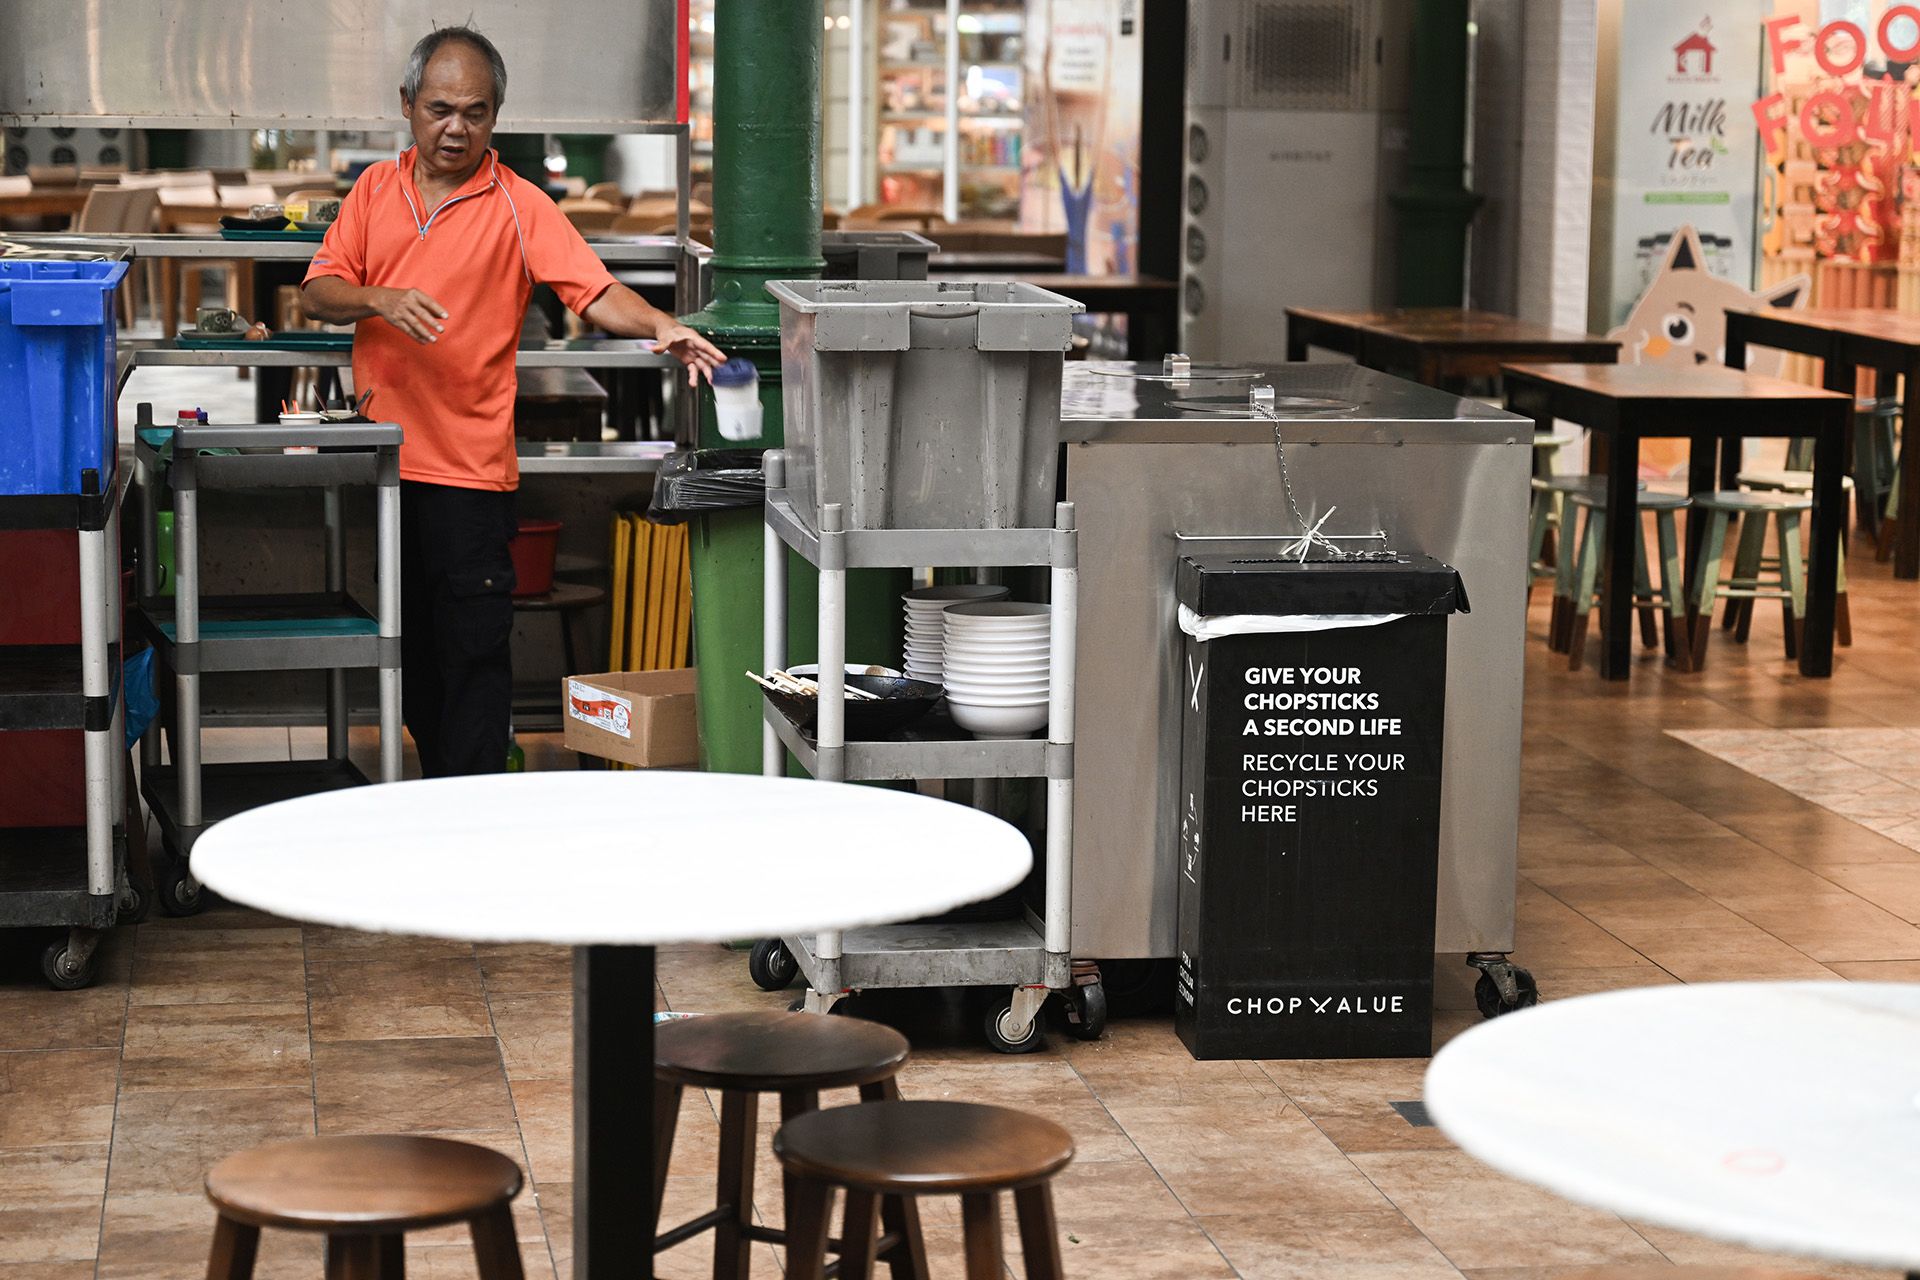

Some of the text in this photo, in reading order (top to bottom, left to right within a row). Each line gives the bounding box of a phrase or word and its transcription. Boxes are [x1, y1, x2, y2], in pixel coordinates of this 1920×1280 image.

[1650, 98, 1726, 136] Milk
[1750, 88, 1920, 155] FOL
[1668, 137, 1714, 170] Tea
[1244, 667, 1361, 685] GIVE YOUR
[1243, 693, 1379, 711] CHOPSTICKS
[1243, 718, 1402, 736] A SECOND LIFE
[1243, 754, 1405, 771] RECYCLE YOUR
[1242, 779, 1378, 797] CHOPSTICKS
[1241, 805, 1297, 822] HERE
